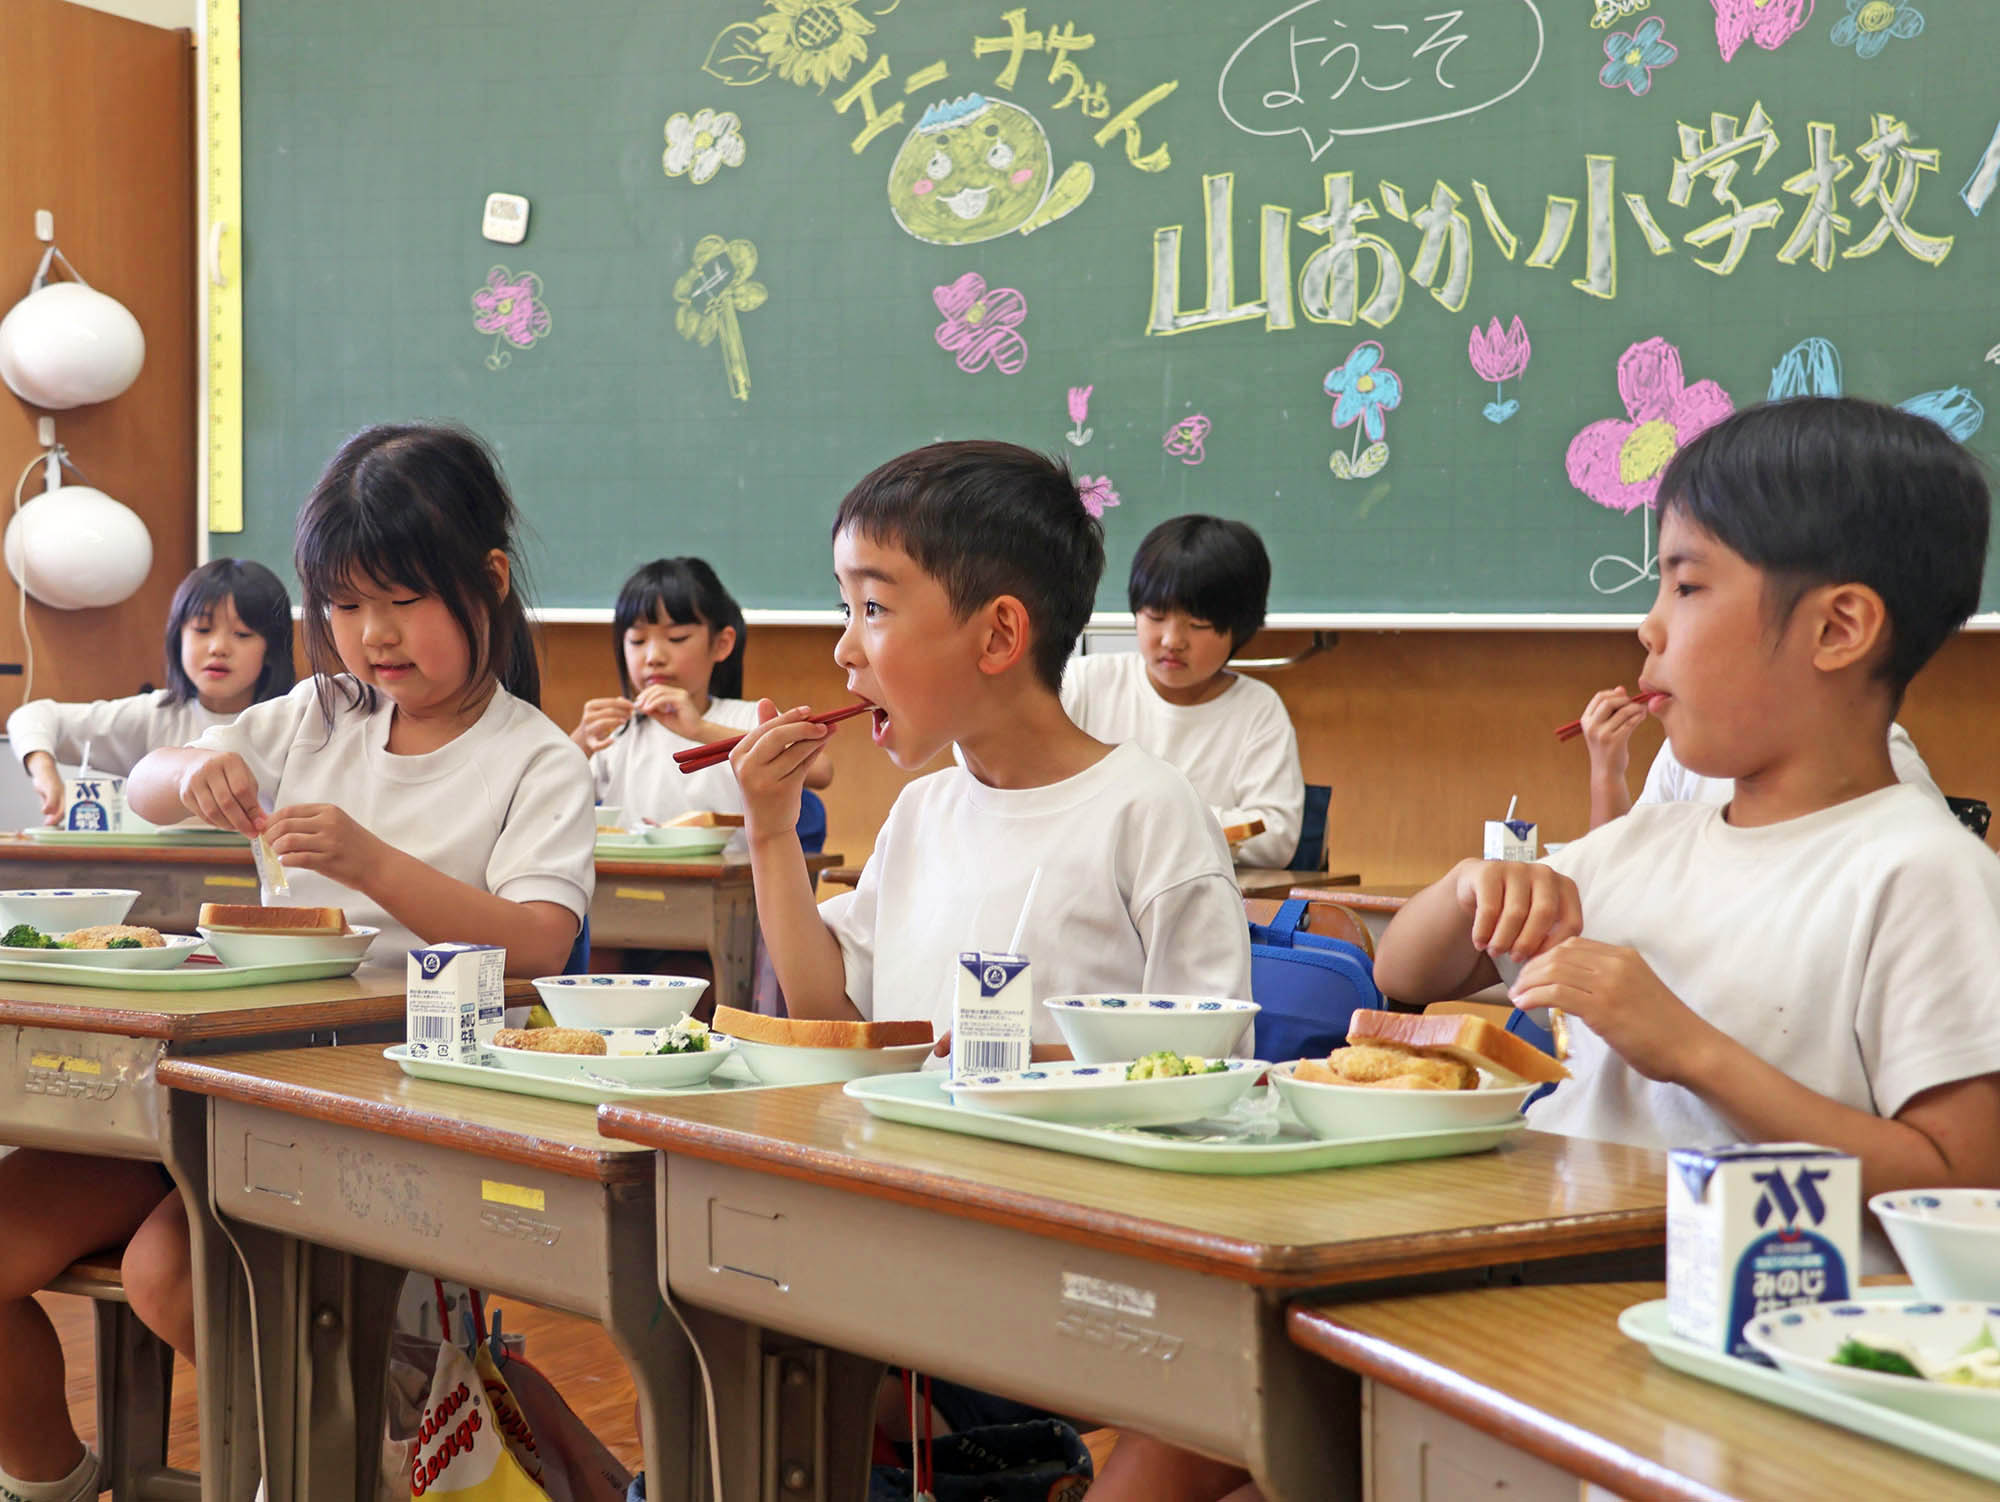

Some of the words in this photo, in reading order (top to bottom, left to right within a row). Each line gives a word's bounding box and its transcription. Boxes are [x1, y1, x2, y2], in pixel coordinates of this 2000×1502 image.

[1262, 10, 1468, 109] ようこそ
[1145, 100, 1955, 335] 山おか小学校
[1751, 1269, 1827, 1298] みのじ
[410, 1409, 482, 1492] George
